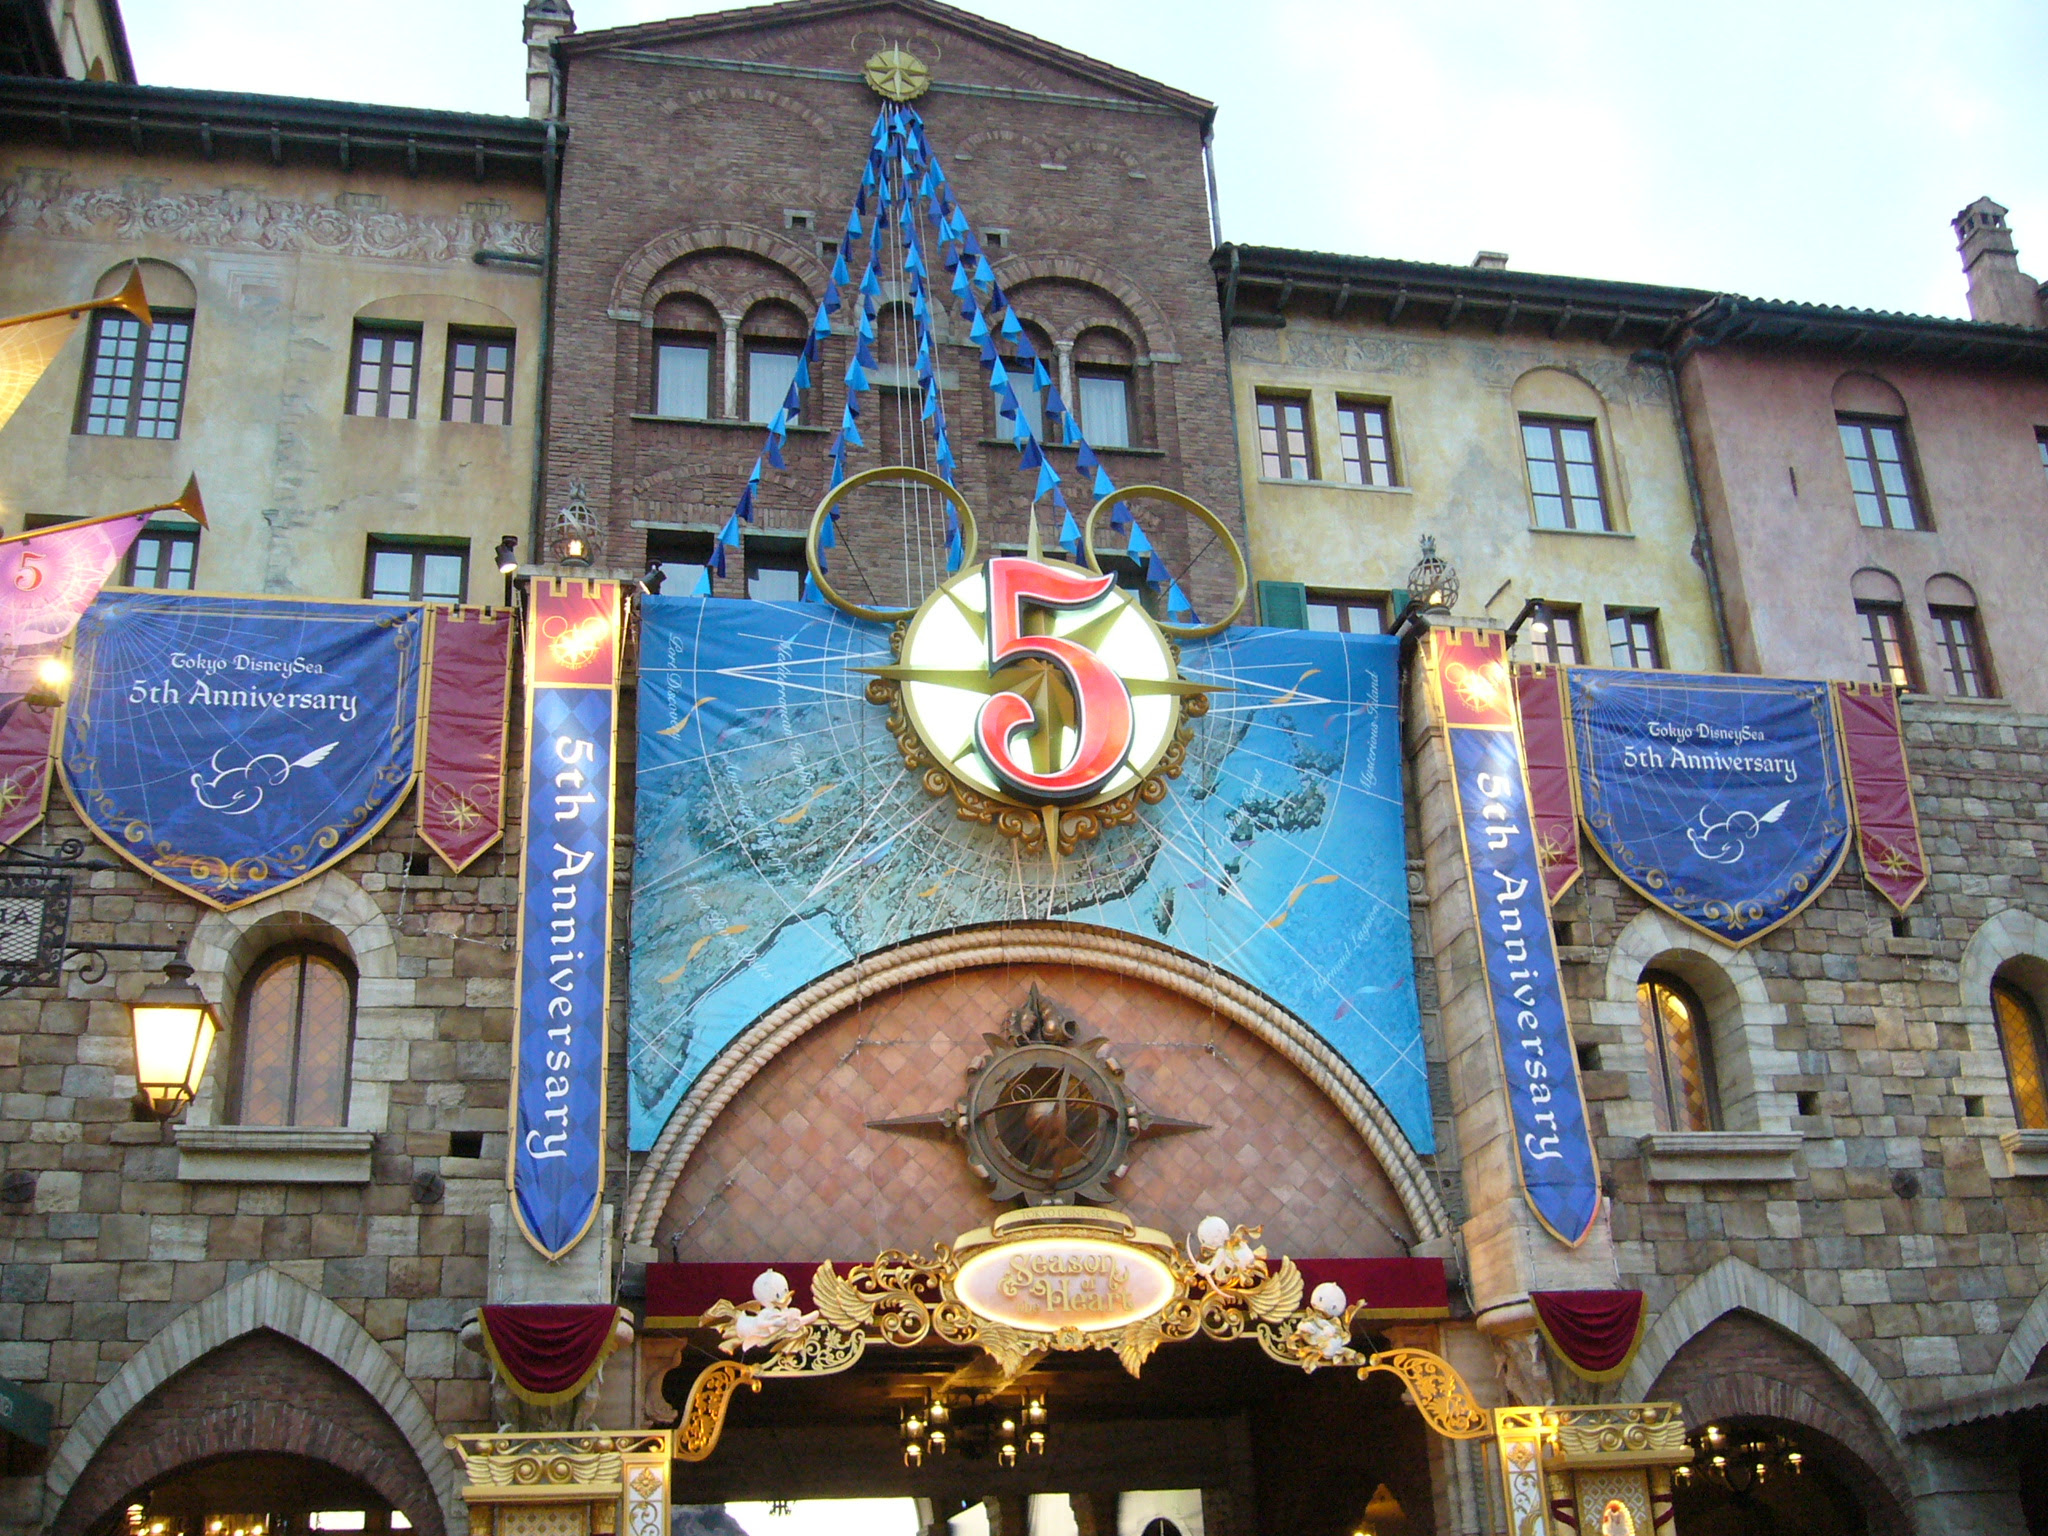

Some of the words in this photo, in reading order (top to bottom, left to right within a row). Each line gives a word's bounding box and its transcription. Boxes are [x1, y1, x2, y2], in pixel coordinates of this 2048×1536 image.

[14, 552, 46, 591] 5
[170, 652, 228, 676] Tokyo
[233, 654, 324, 679] DisneySea
[974, 557, 1117, 804] 5
[128, 679, 180, 704] 5th
[188, 679, 358, 722] Anniversary
[1647, 721, 1693, 743] Tokyo
[1696, 723, 1765, 745] DisneySea
[1359, 721, 1380, 791] Mysterious
[1623, 746, 1664, 768] 5th
[1670, 746, 1798, 783] Anniversary
[555, 735, 596, 822] 5th
[1477, 771, 1520, 851] 5th
[525, 842, 595, 1160] Anniversary
[1493, 869, 1563, 1161] Anniversary
[1022, 1208, 1055, 1219] TOKYO
[1057, 1208, 1109, 1218] DISNEYSEA
[998, 1253, 1130, 1297] Season
[1029, 1278, 1134, 1312] Heart
[1080, 1277, 1097, 1292] of
